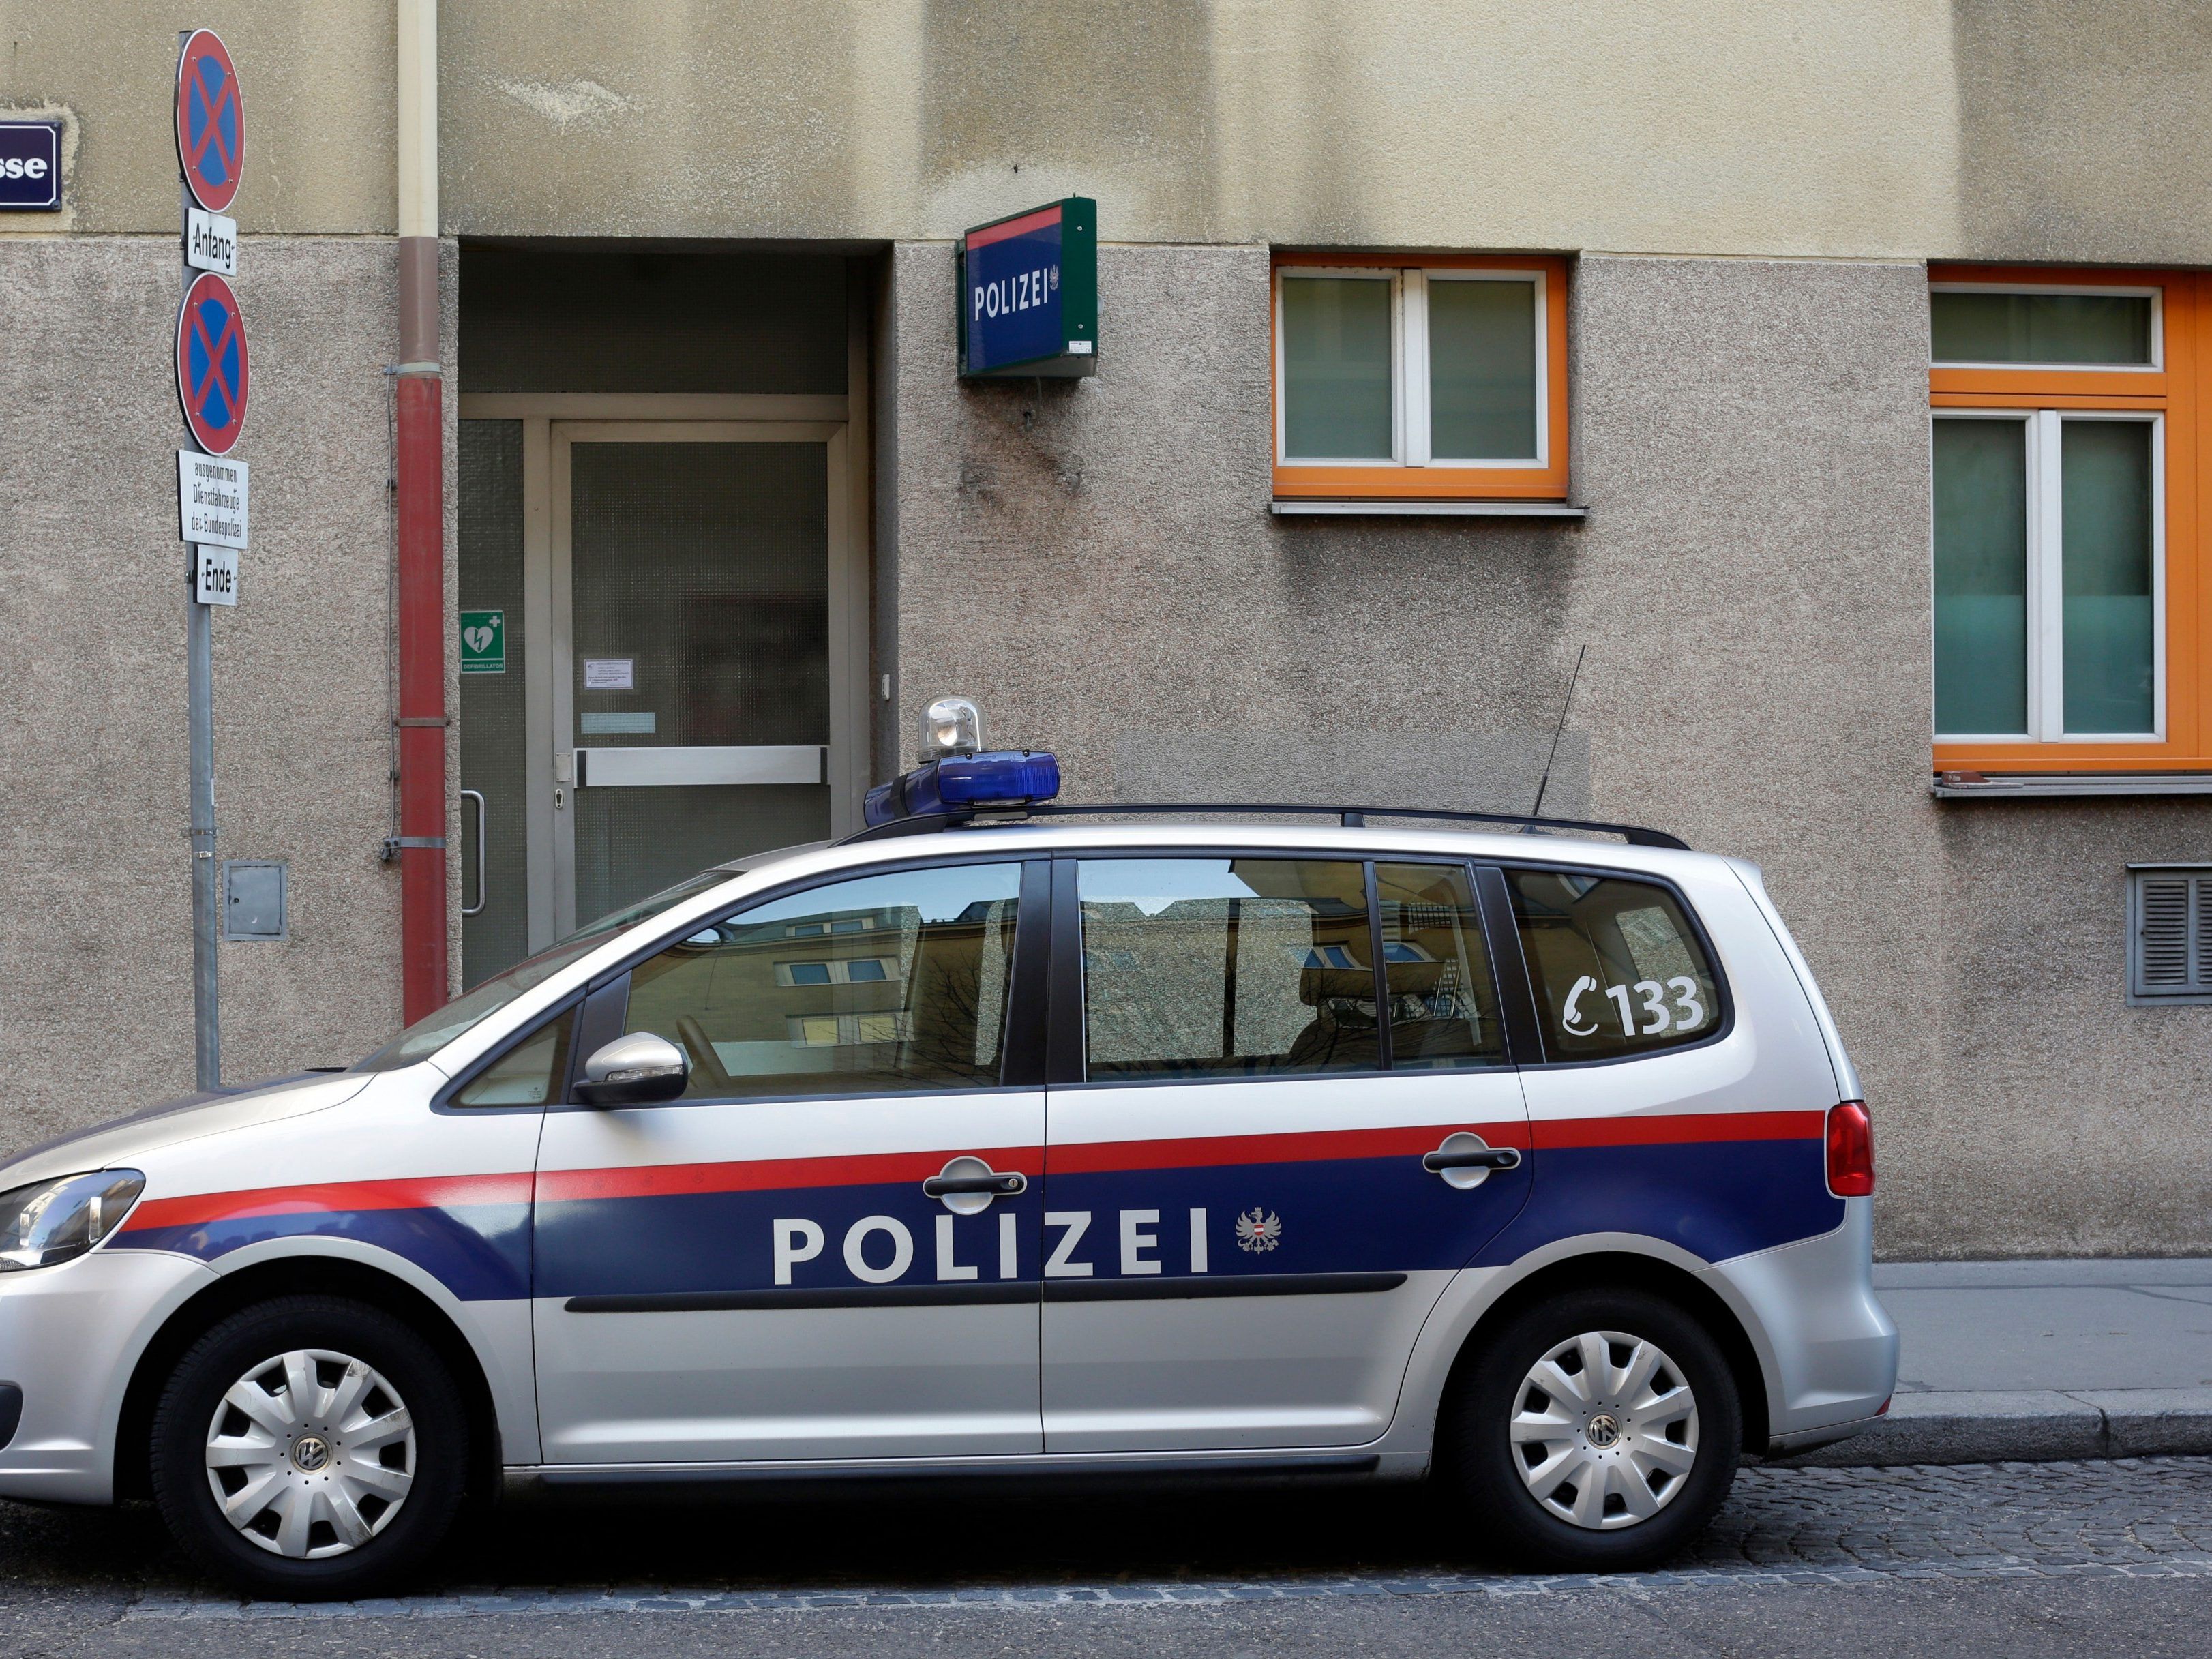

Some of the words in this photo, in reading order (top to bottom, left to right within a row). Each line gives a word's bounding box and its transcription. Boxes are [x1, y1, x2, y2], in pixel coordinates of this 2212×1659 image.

[194, 222, 231, 269] Anfang
[974, 267, 1048, 321] POLIZEI
[194, 462, 237, 483] ausgenommen
[193, 483, 239, 514] Dienstfahrzeuge
[192, 511, 203, 531] der
[204, 513, 242, 539] Bundespolizei
[205, 558, 232, 593] Ende
[1604, 976, 1704, 1036] 133
[772, 1207, 1208, 1285] POLIZEI
